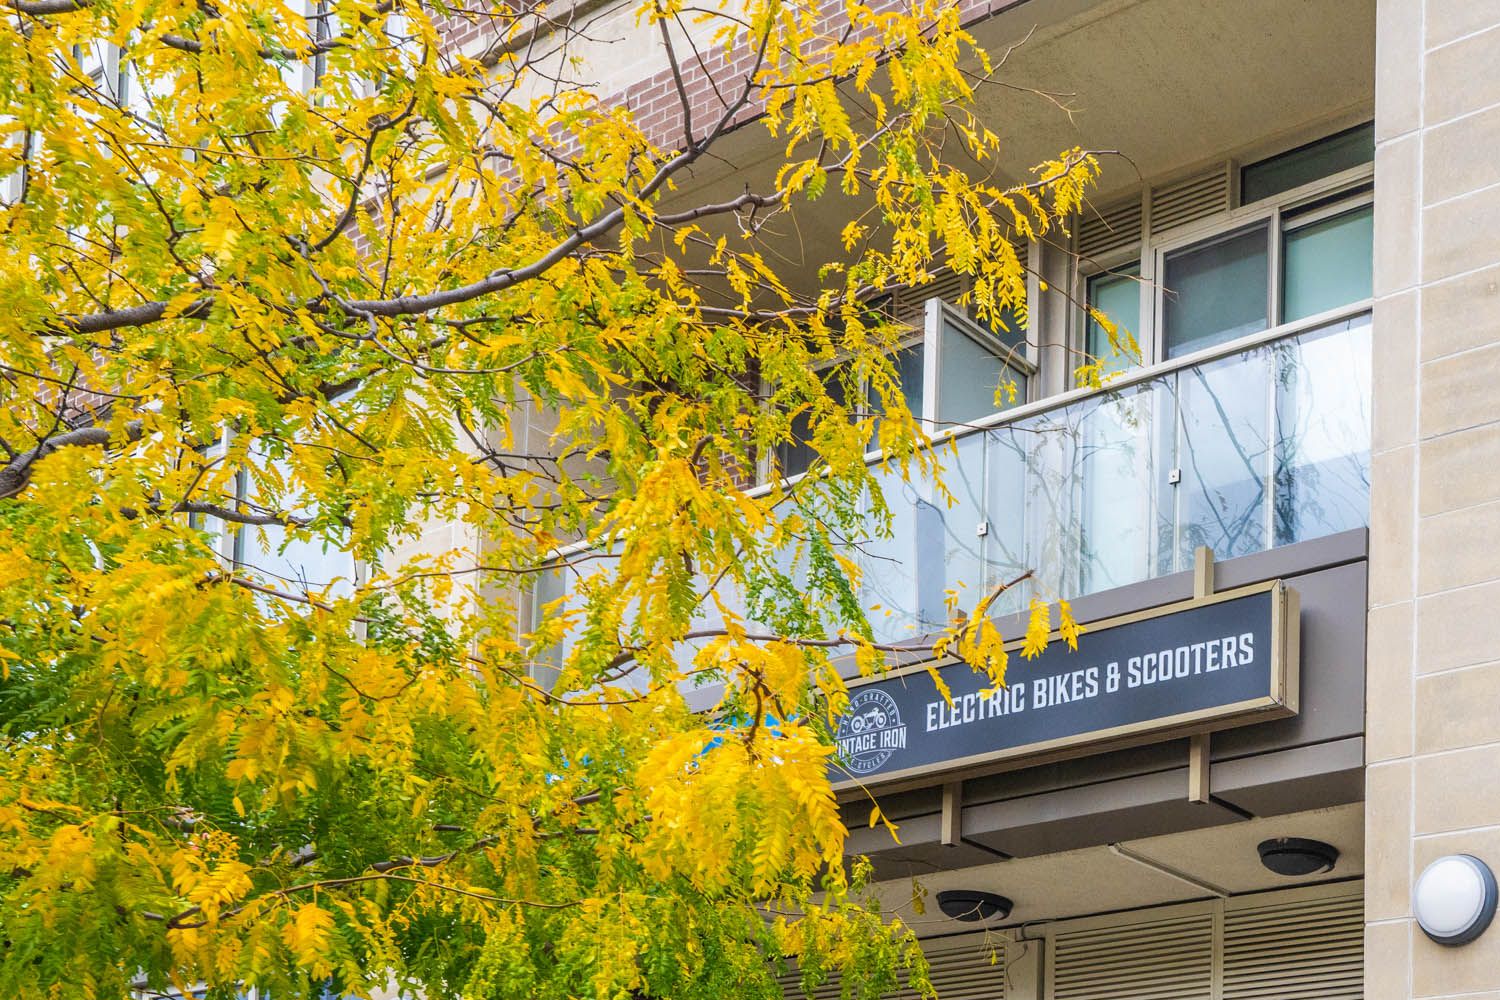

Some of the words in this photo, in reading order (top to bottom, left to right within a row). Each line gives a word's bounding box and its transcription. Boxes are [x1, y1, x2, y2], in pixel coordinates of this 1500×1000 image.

[926, 682, 1025, 732] ELECTRIC
[1033, 667, 1099, 709] BIKES
[1106, 661, 1122, 693] &
[1127, 632, 1255, 685] SCOOTERS
[843, 690, 896, 726] HND-CRAFTED
[835, 731, 876, 758] INTAGE
[880, 726, 907, 749] IRON
